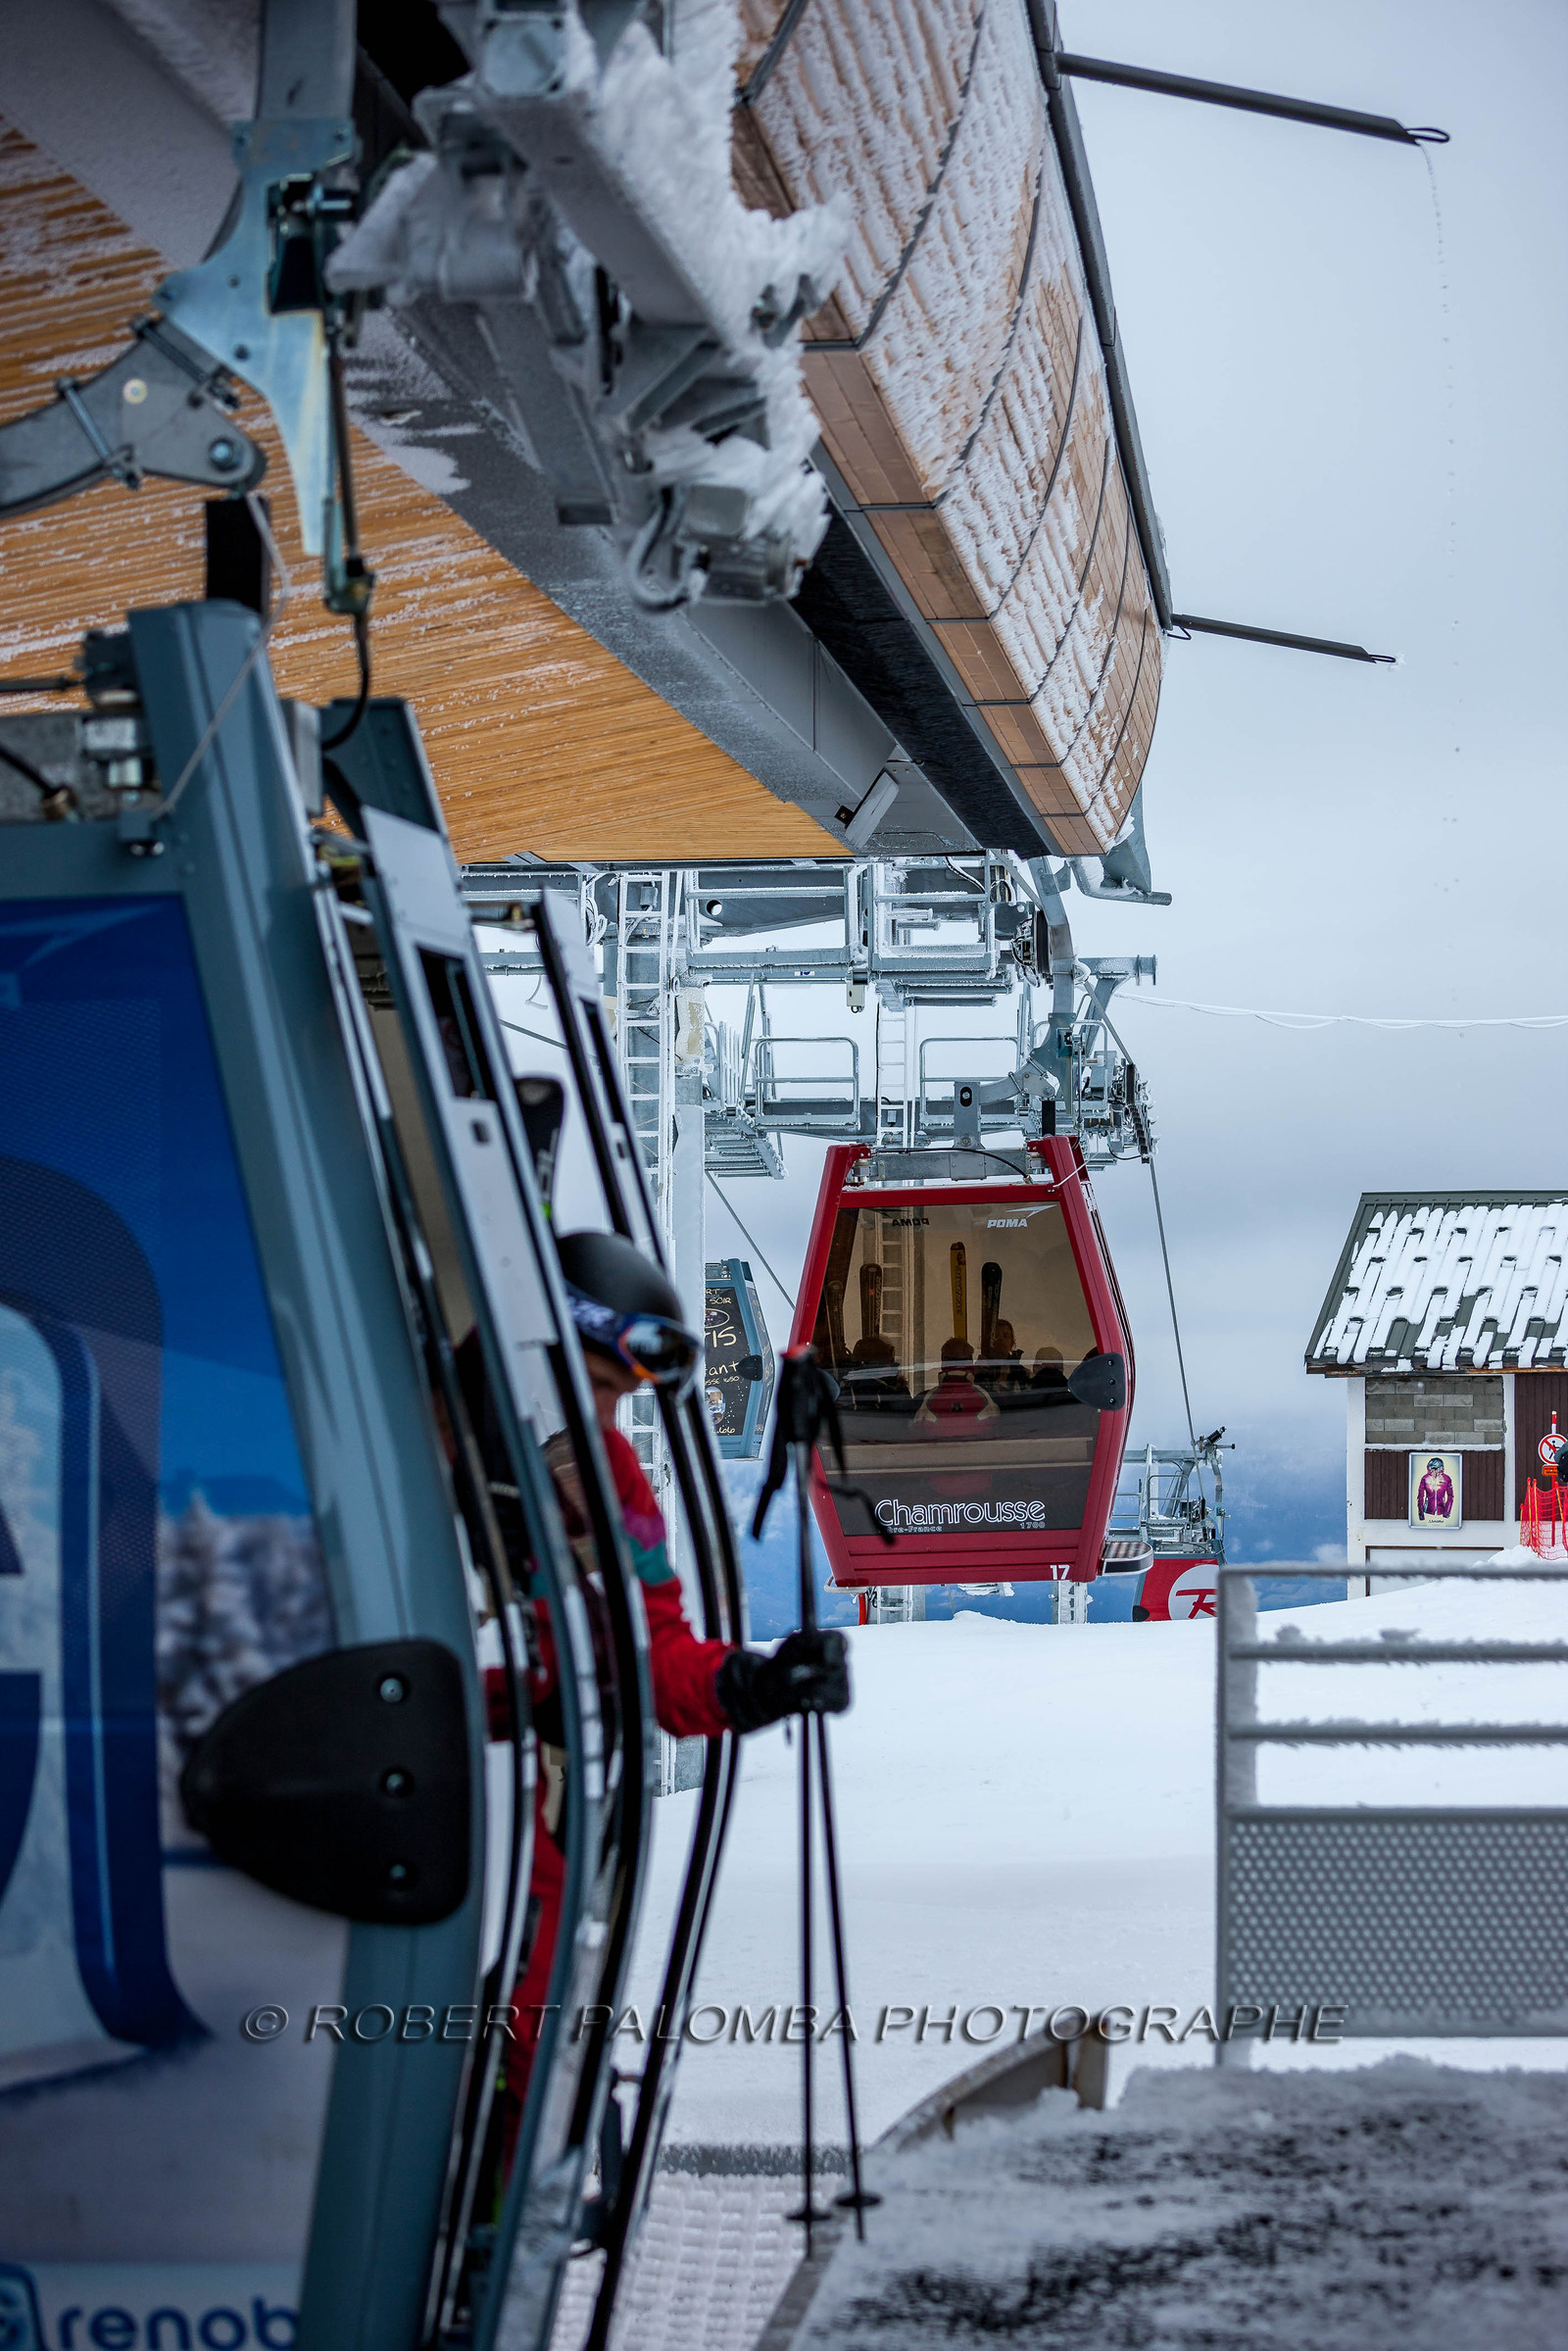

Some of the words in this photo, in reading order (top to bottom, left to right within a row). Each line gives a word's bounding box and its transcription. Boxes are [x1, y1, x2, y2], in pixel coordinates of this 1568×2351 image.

[987, 1218, 1028, 1228] POMA
[705, 1361, 739, 1376] ant
[875, 1498, 1046, 1527] Chamrousse
[1050, 1565, 1070, 1580] 17
